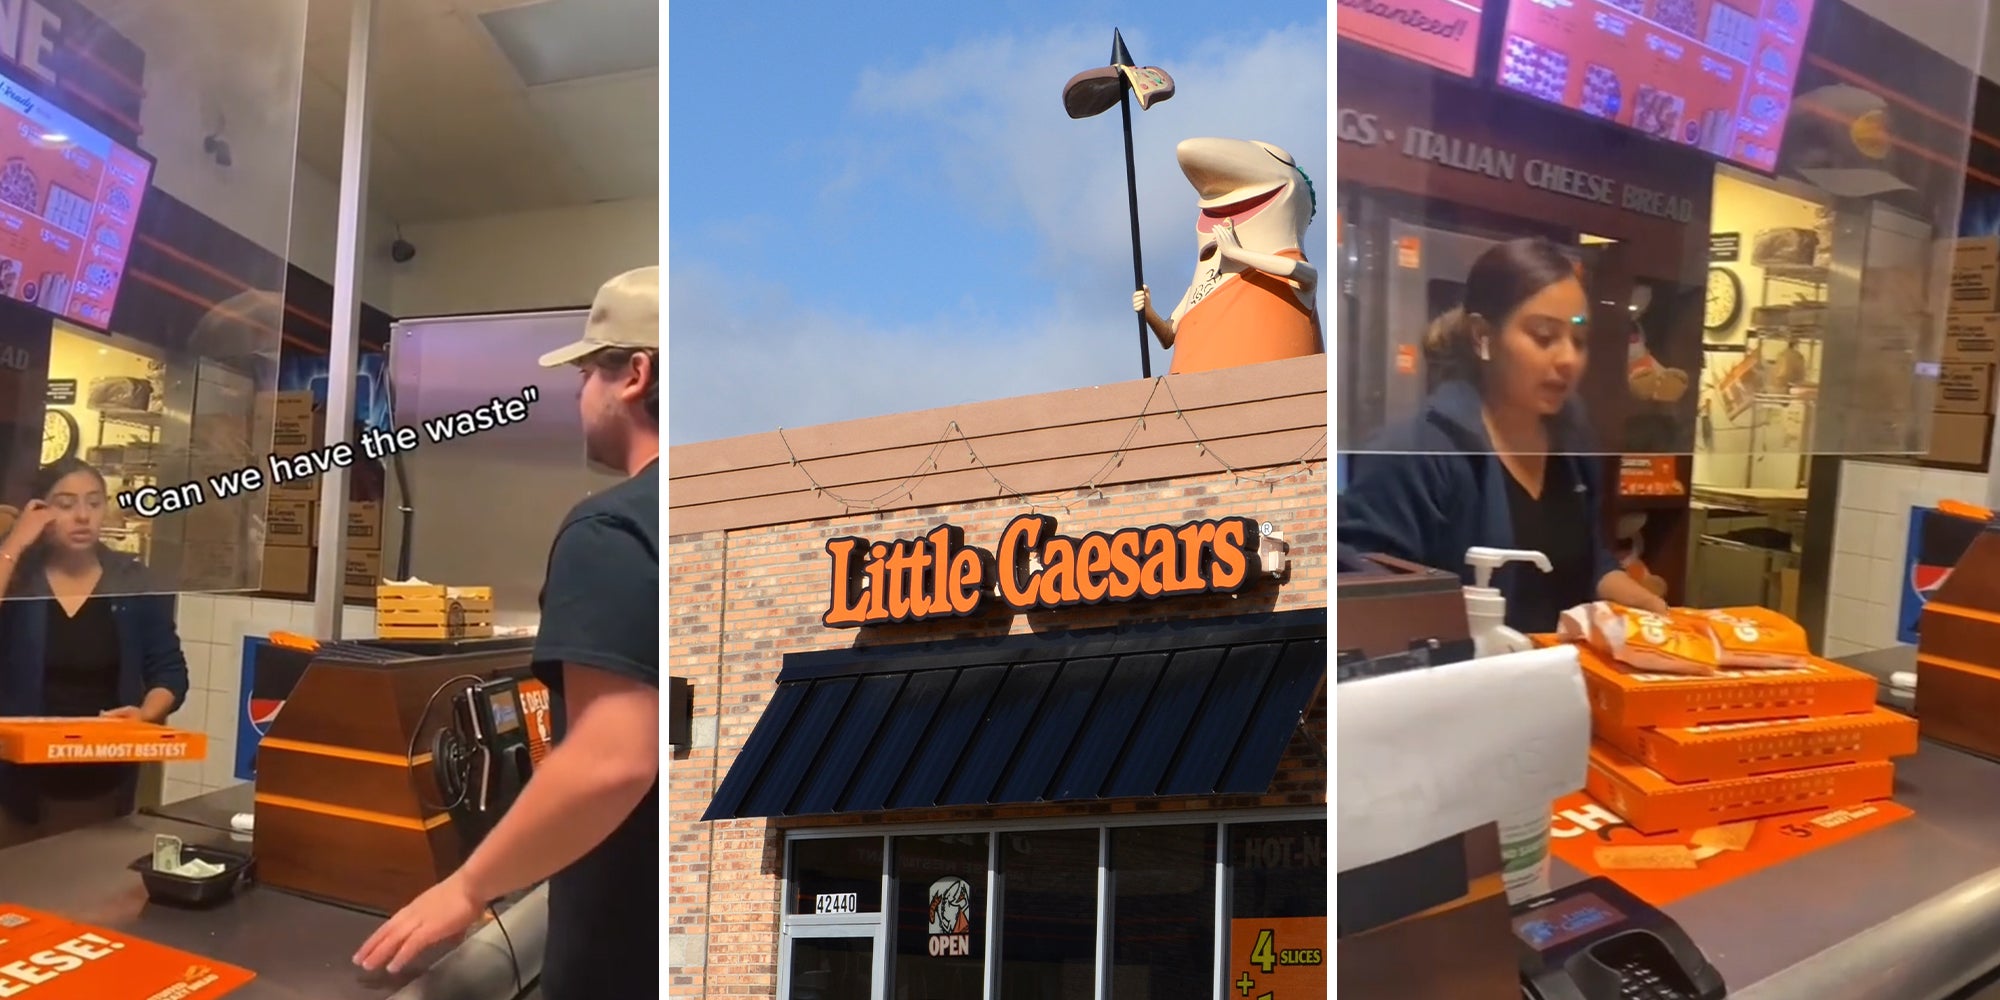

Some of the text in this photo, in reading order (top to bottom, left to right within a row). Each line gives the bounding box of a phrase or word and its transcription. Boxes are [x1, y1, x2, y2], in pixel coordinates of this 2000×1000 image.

[1402, 126, 1517, 181] ITALIAN
[1523, 159, 1616, 205] CHEESE
[1621, 183, 1693, 224] BREAD
[823, 525, 983, 627] Little
[997, 515, 1249, 609] Caesars
[47, 742, 188, 759] EXTRA MOST BESTEST
[816, 894, 856, 914] 42440
[928, 934, 970, 957] OPEN
[1250, 928, 1323, 974] 4 SLICES
